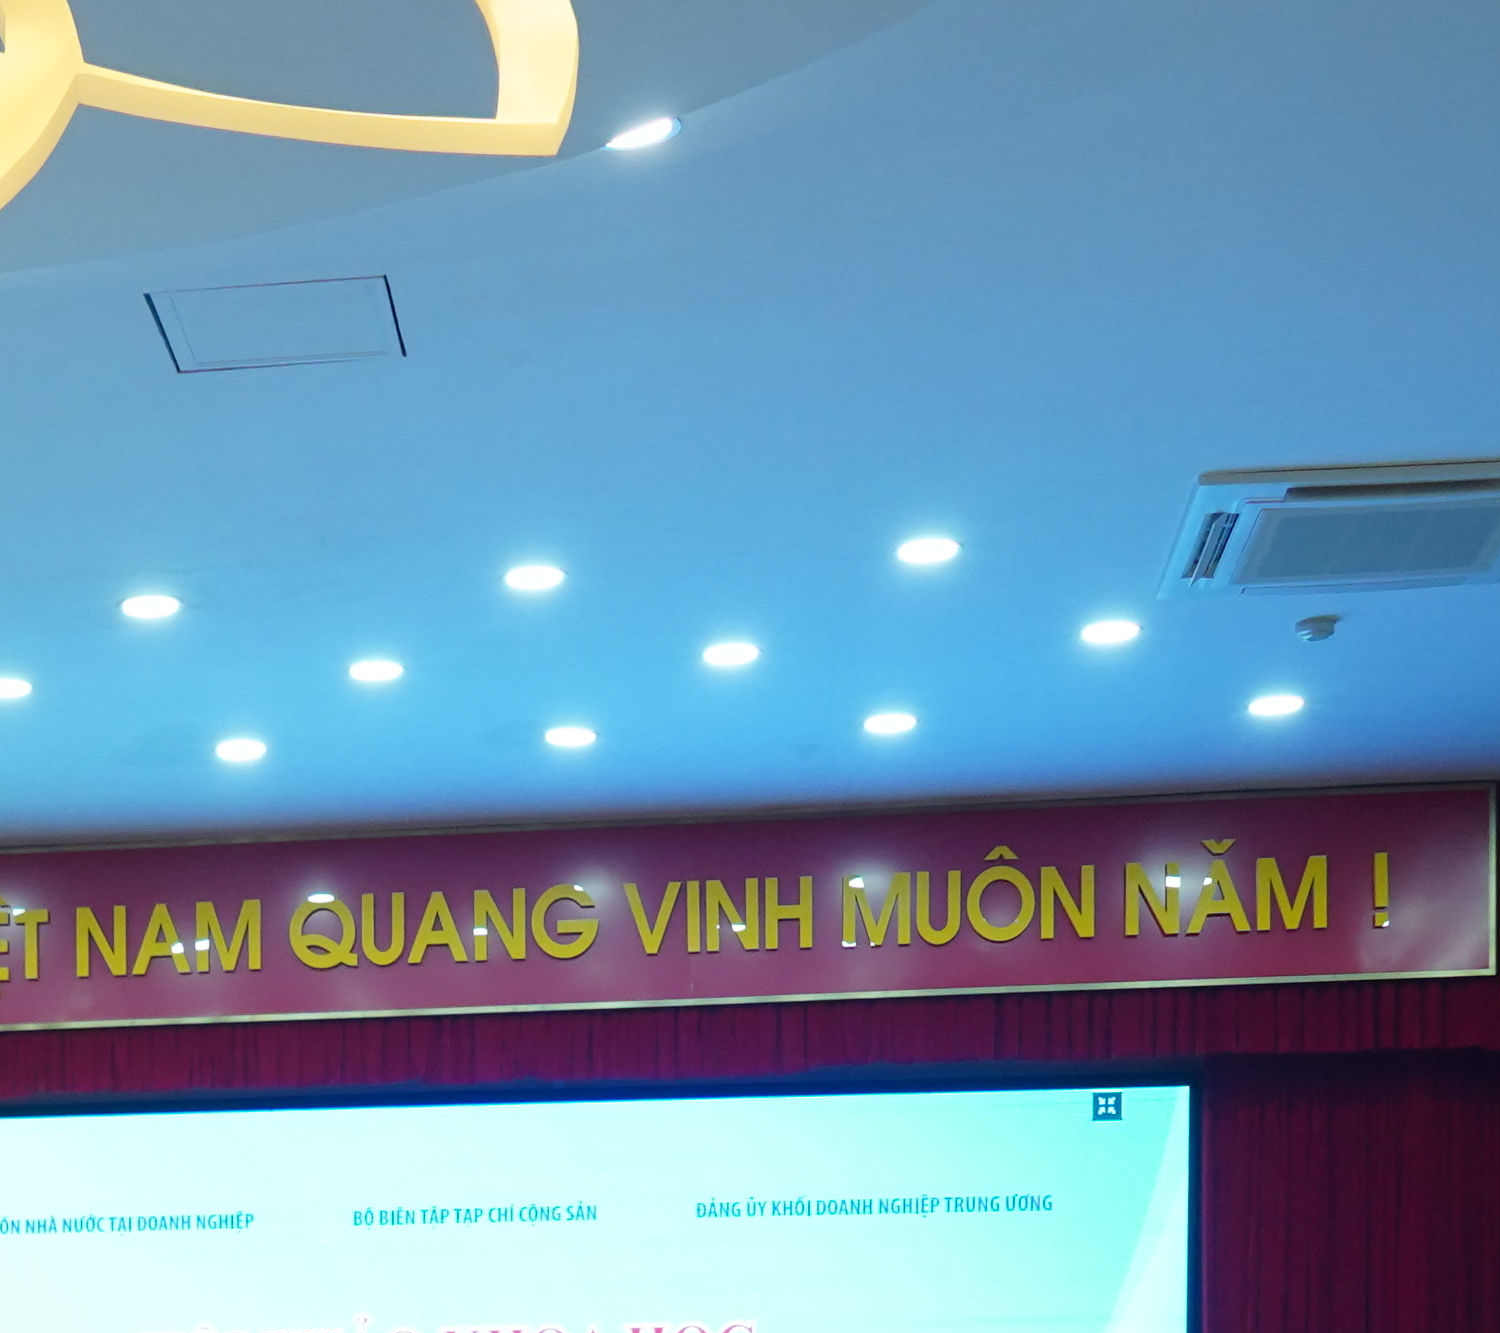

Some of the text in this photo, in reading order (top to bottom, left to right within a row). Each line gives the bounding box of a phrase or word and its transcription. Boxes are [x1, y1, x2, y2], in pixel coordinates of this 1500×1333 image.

[76, 899, 263, 979] NAM
[289, 882, 600, 970] QUANG
[624, 875, 813, 956] VINH
[840, 845, 1095, 949] MUÔN
[1123, 838, 1328, 938] NĂM
[1371, 851, 1391, 930] !
[352, 1200, 597, 1227] BỘ BIÊN TẬP TẠP CHÍ CỘNG SẢN
[695, 1193, 1053, 1219] ĐẢNG ỦY KHỐI DOANH NGHIỆP TRUNG ƯƠNG
[25, 1215, 58, 1234] NHÀ
[61, 1214, 105, 1234] NƯỚC
[107, 1216, 133, 1233] TẠI
[136, 1214, 192, 1232] DOANH
[195, 1210, 255, 1230] NGHIỆP
